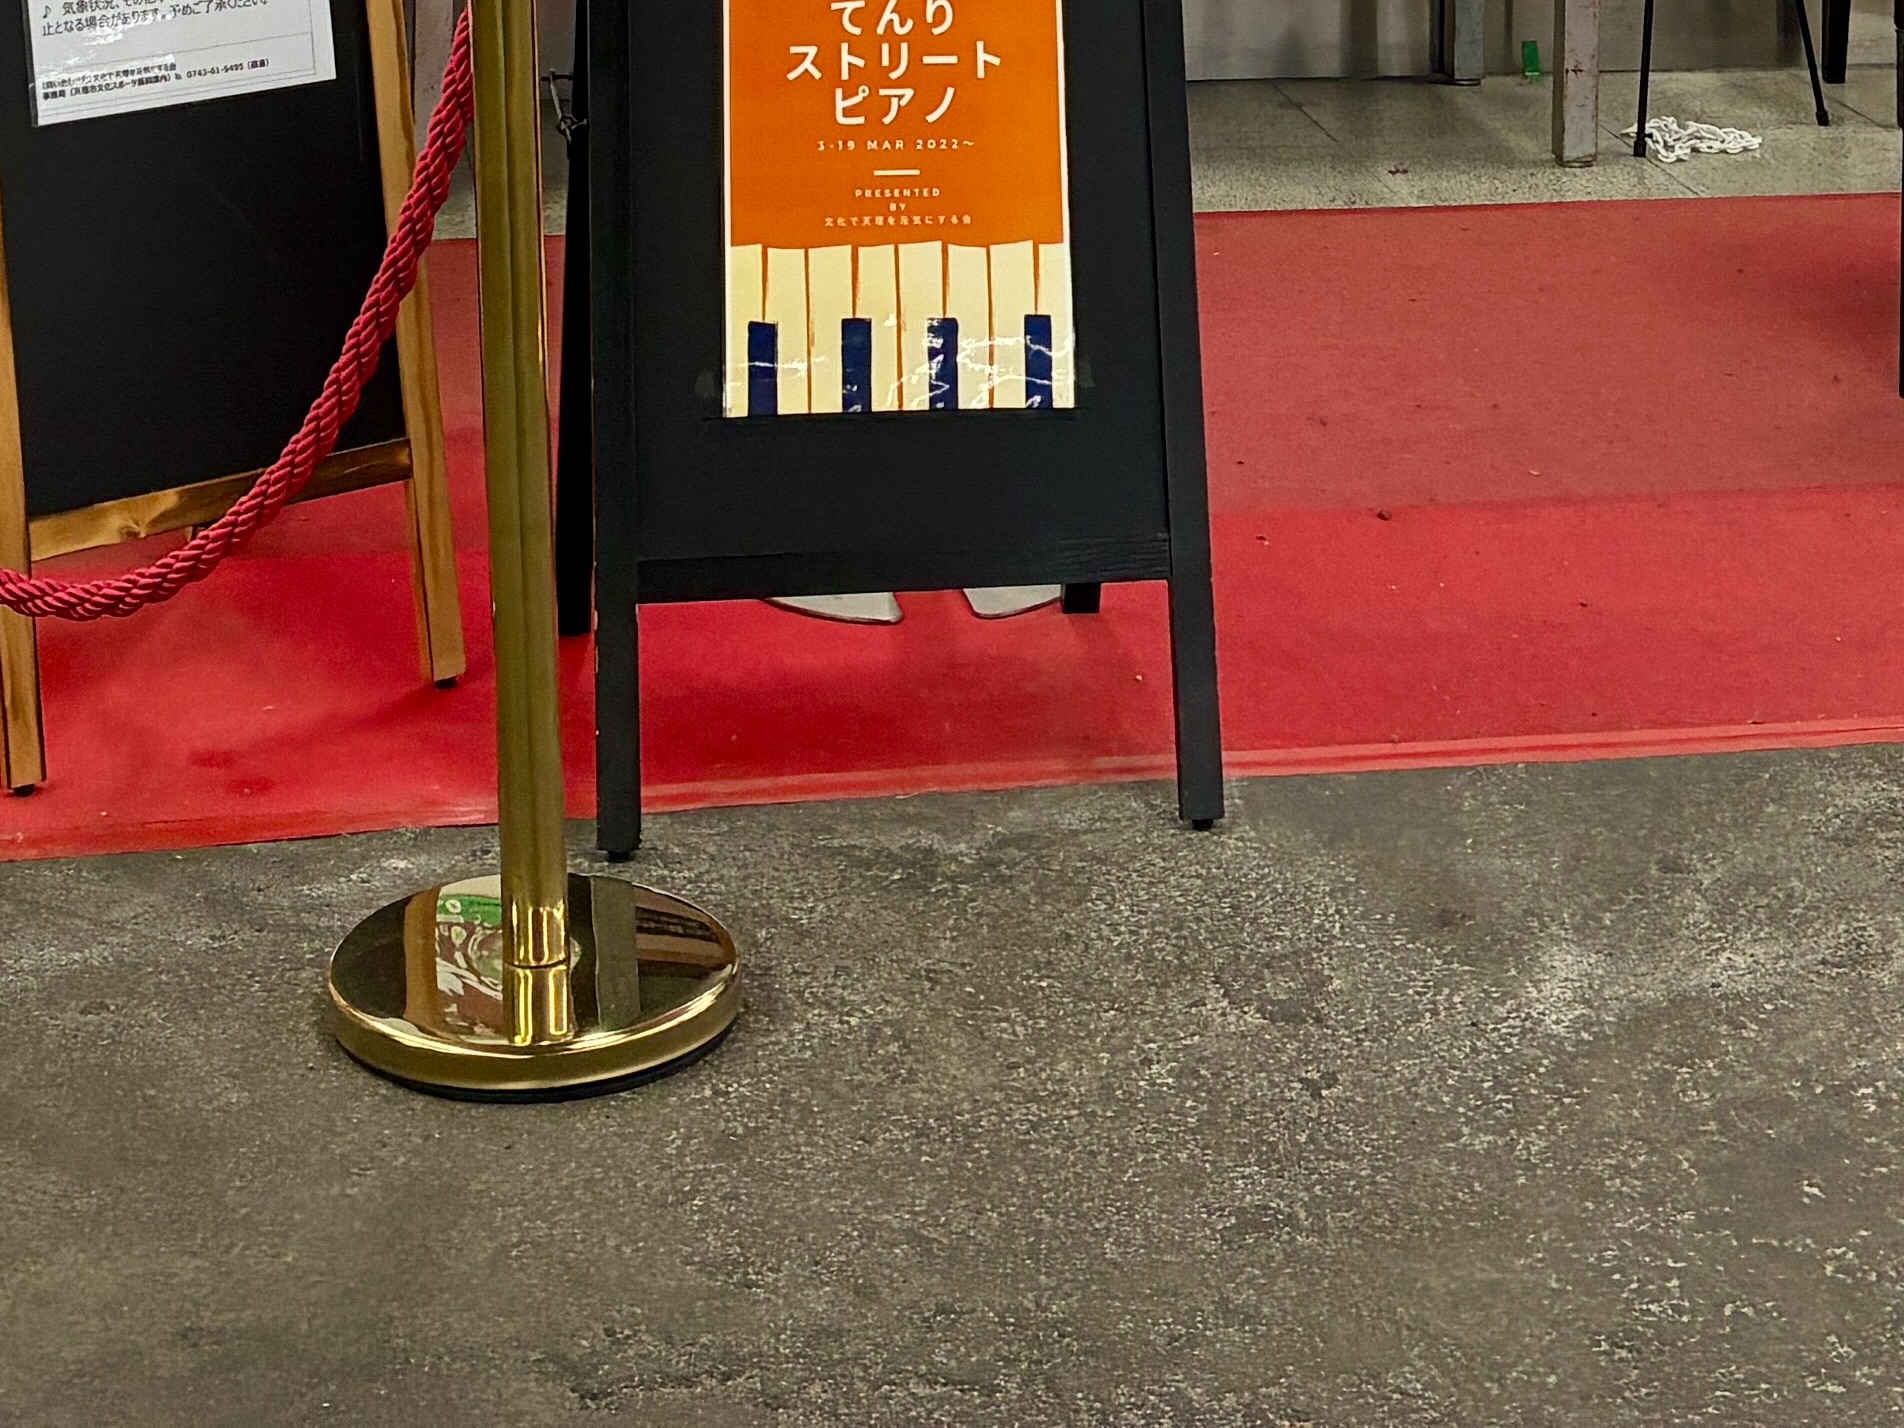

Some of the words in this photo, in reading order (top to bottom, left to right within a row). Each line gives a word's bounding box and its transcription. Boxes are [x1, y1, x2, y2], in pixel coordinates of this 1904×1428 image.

[786, 39, 1002, 81] ストリート
[834, 85, 957, 126] ピアノ
[866, 139, 905, 151] MAR
[854, 187, 941, 198] PRESENTED
[889, 202, 907, 212] BY
[824, 214, 973, 227] 文化で天理を元気にする会
